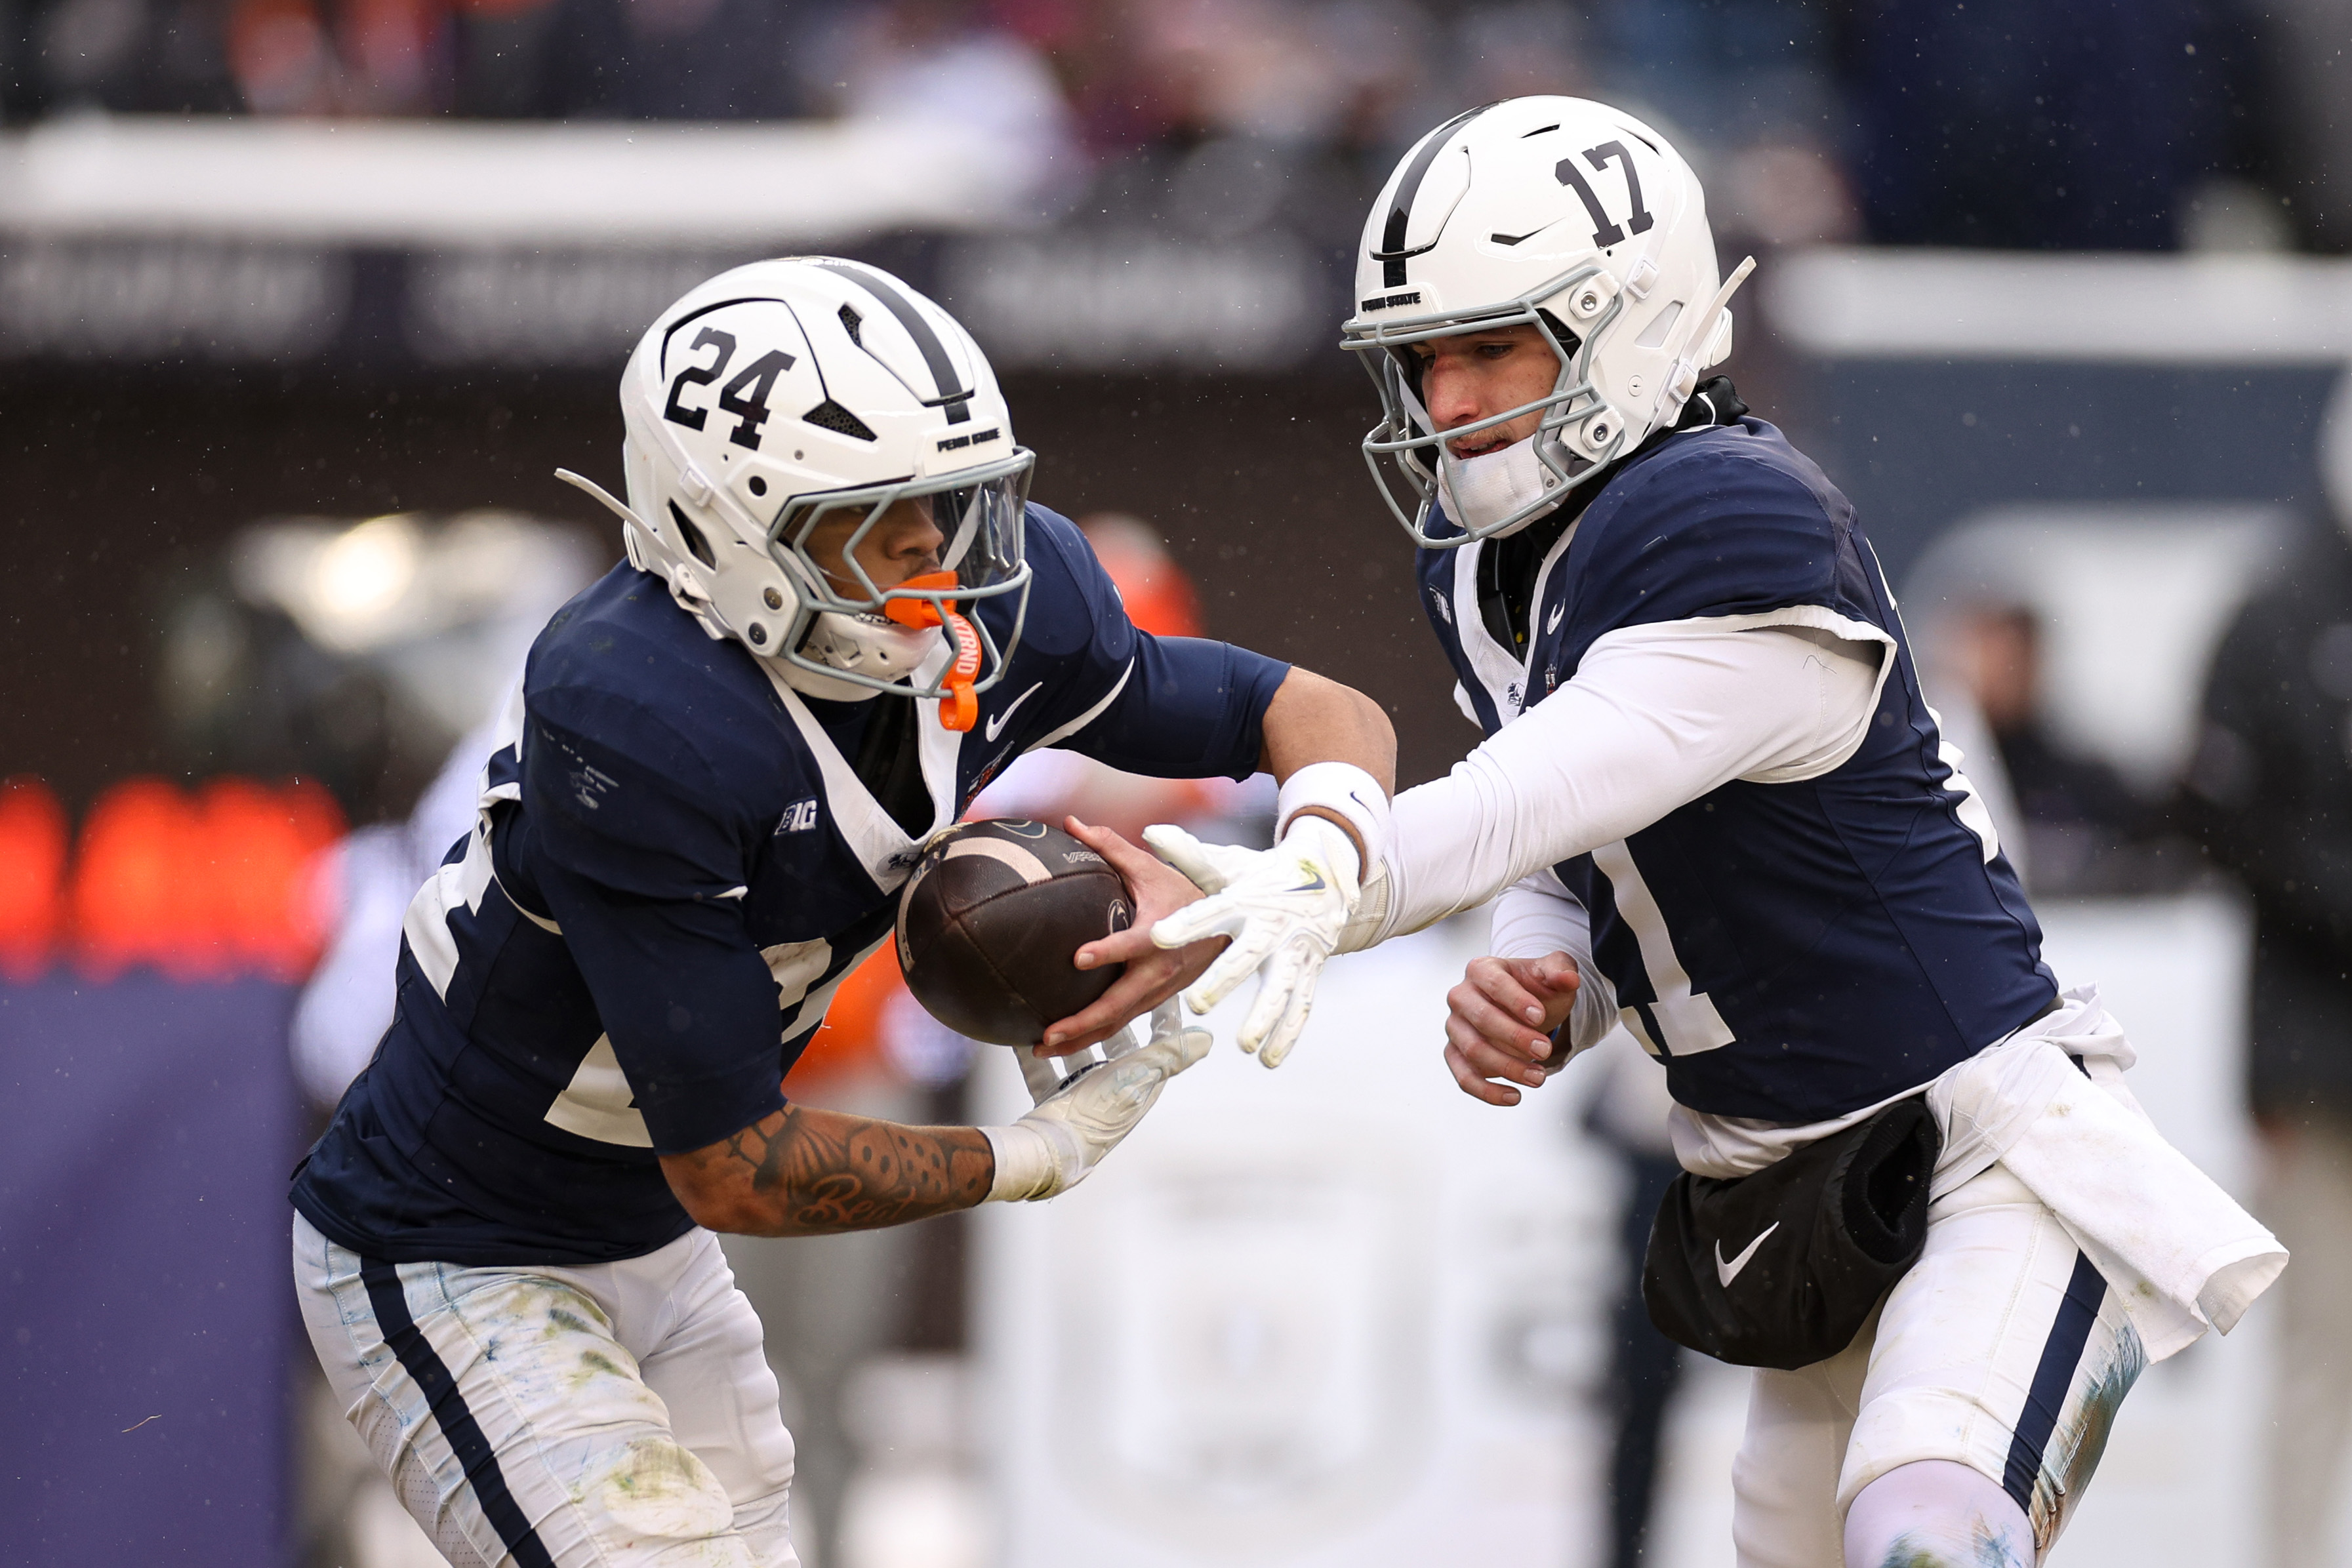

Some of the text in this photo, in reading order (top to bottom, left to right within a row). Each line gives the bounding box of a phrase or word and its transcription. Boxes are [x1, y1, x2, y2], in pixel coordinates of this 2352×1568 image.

[1555, 140, 1654, 249] 17
[1386, 292, 1422, 308] STATE
[663, 327, 796, 451] 24
